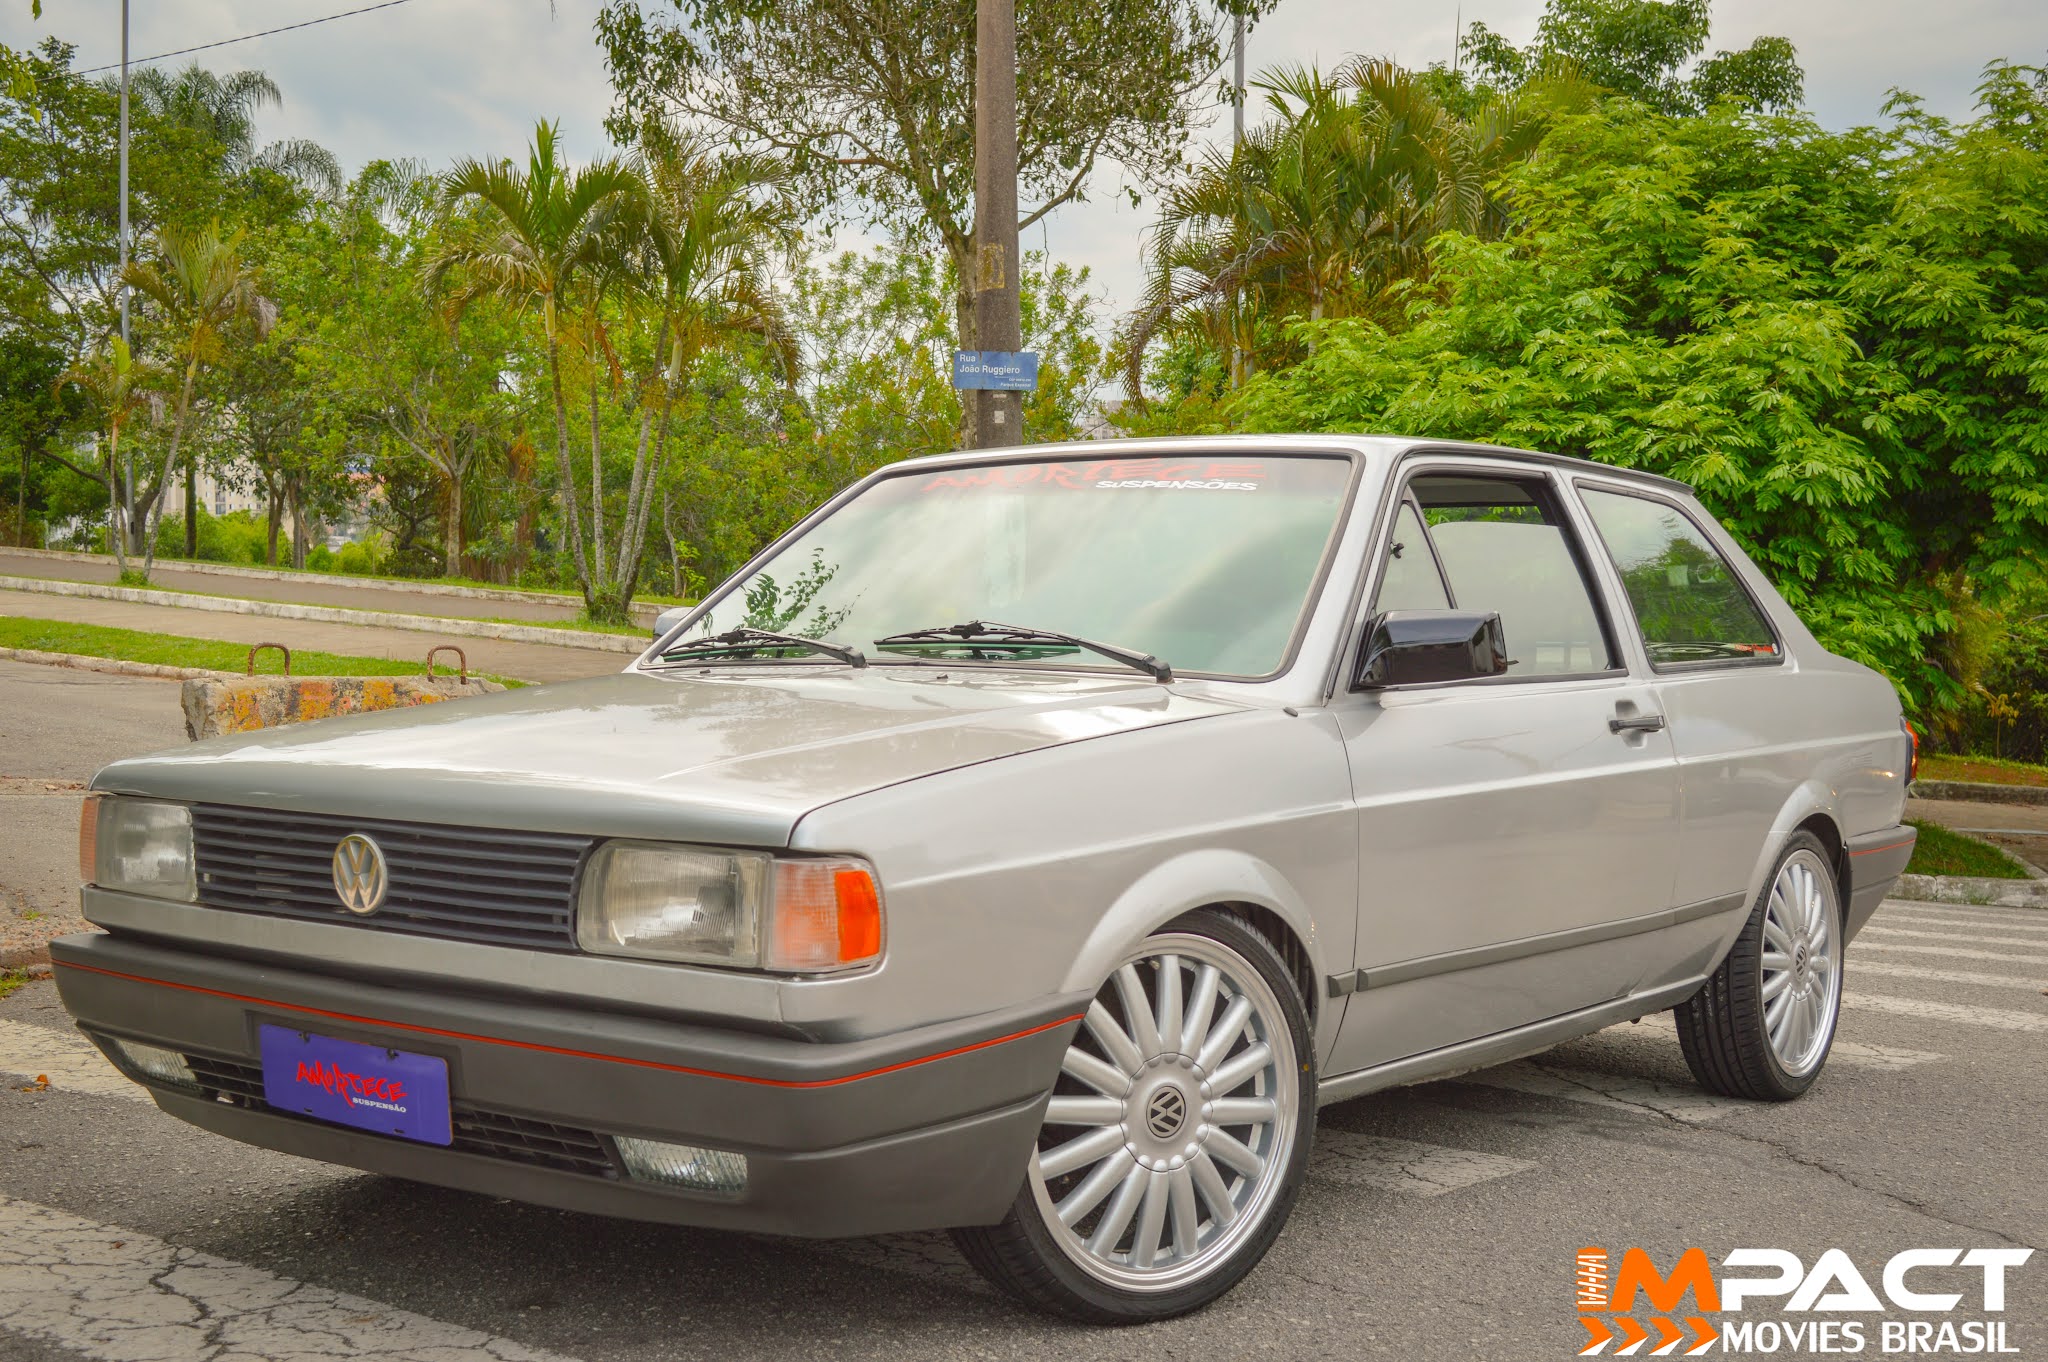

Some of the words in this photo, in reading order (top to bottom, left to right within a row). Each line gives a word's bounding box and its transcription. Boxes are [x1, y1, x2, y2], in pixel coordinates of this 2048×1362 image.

[960, 354, 976, 362] Rua
[960, 365, 980, 373] João
[982, 365, 1021, 375] Ruggiero
[922, 457, 1267, 493] AMORTECE
[296, 1060, 408, 1108] AMORTECE
[352, 1096, 407, 1113] SUSPENSÃO
